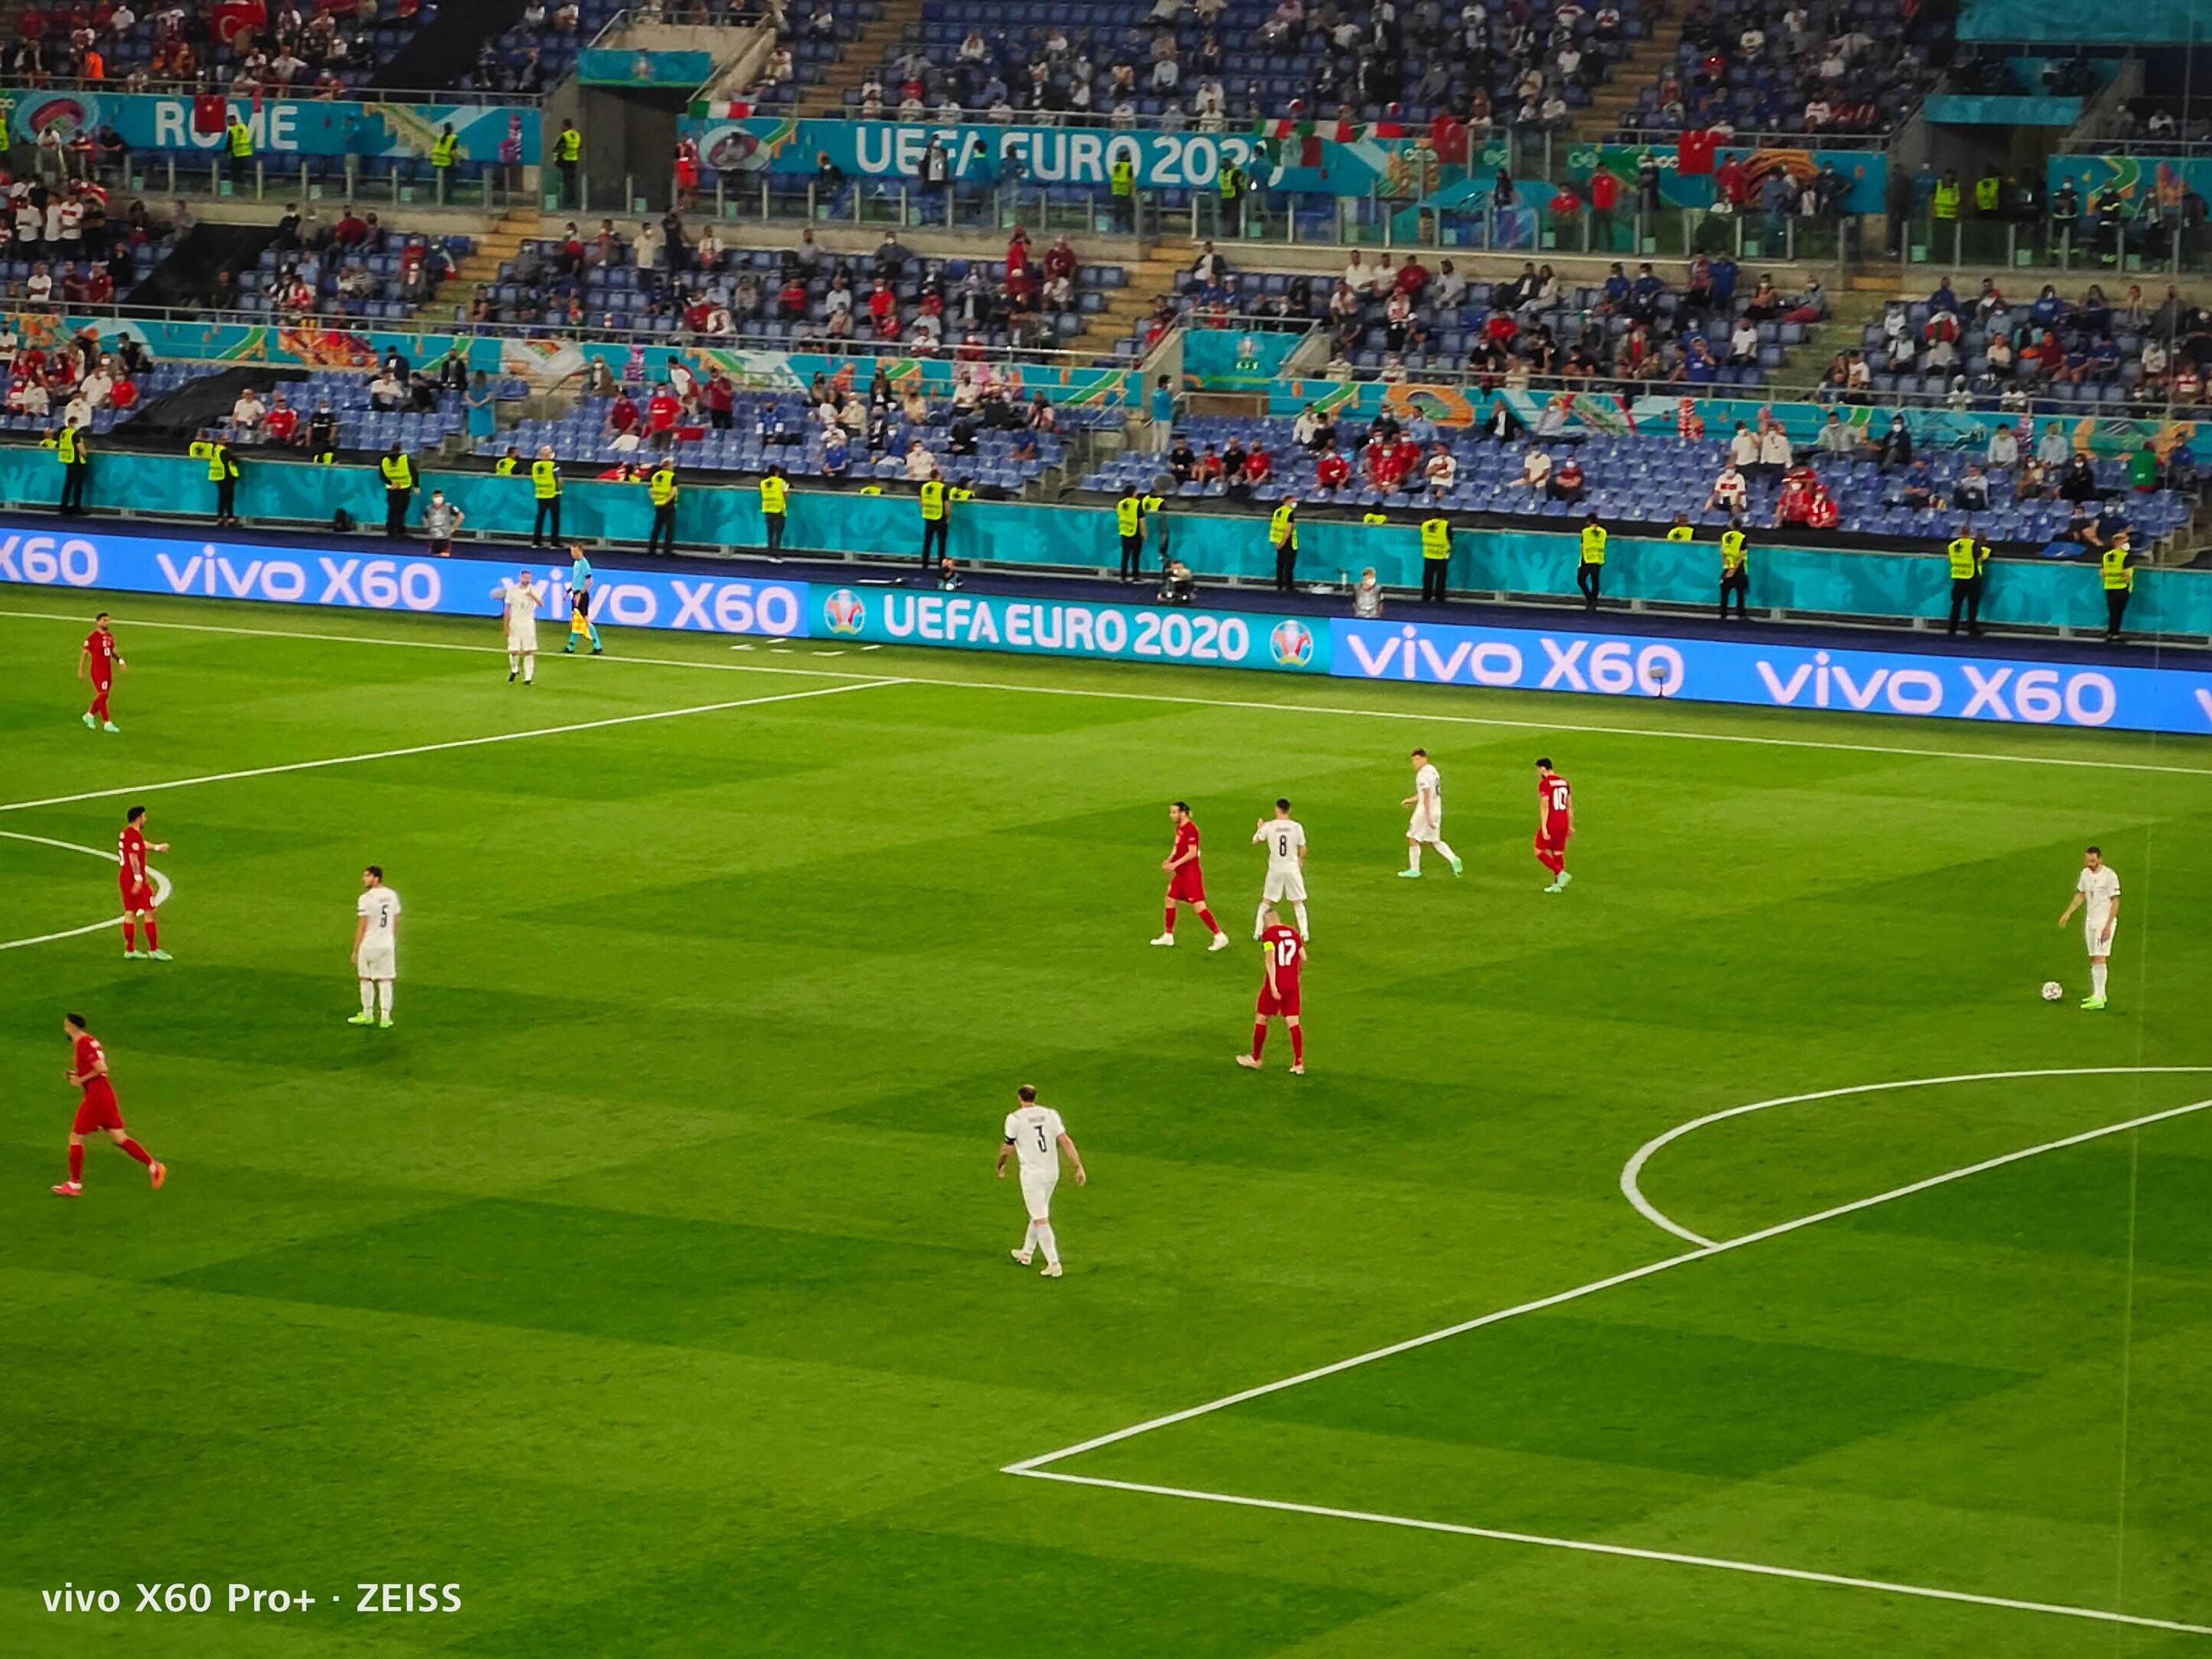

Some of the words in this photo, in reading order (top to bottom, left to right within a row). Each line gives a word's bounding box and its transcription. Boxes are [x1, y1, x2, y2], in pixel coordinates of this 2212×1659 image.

[1000, 132, 1141, 182] EURO
[1150, 135, 1285, 187] 202
[157, 544, 306, 602] vivo
[318, 549, 441, 611] X60
[670, 580, 799, 635] X60
[883, 594, 999, 644] UEFA
[1005, 603, 1128, 652] EURO
[1134, 612, 1249, 660] 2020
[1347, 625, 1523, 686] vivo
[1539, 637, 1684, 696] X60
[1756, 650, 1943, 714] vivo
[1961, 665, 2117, 726] X60
[1553, 786, 1568, 811] 10
[1279, 834, 1287, 857] 8
[380, 905, 388, 928] 5
[1277, 938, 1297, 967] 17
[1034, 1125, 1047, 1152] 3
